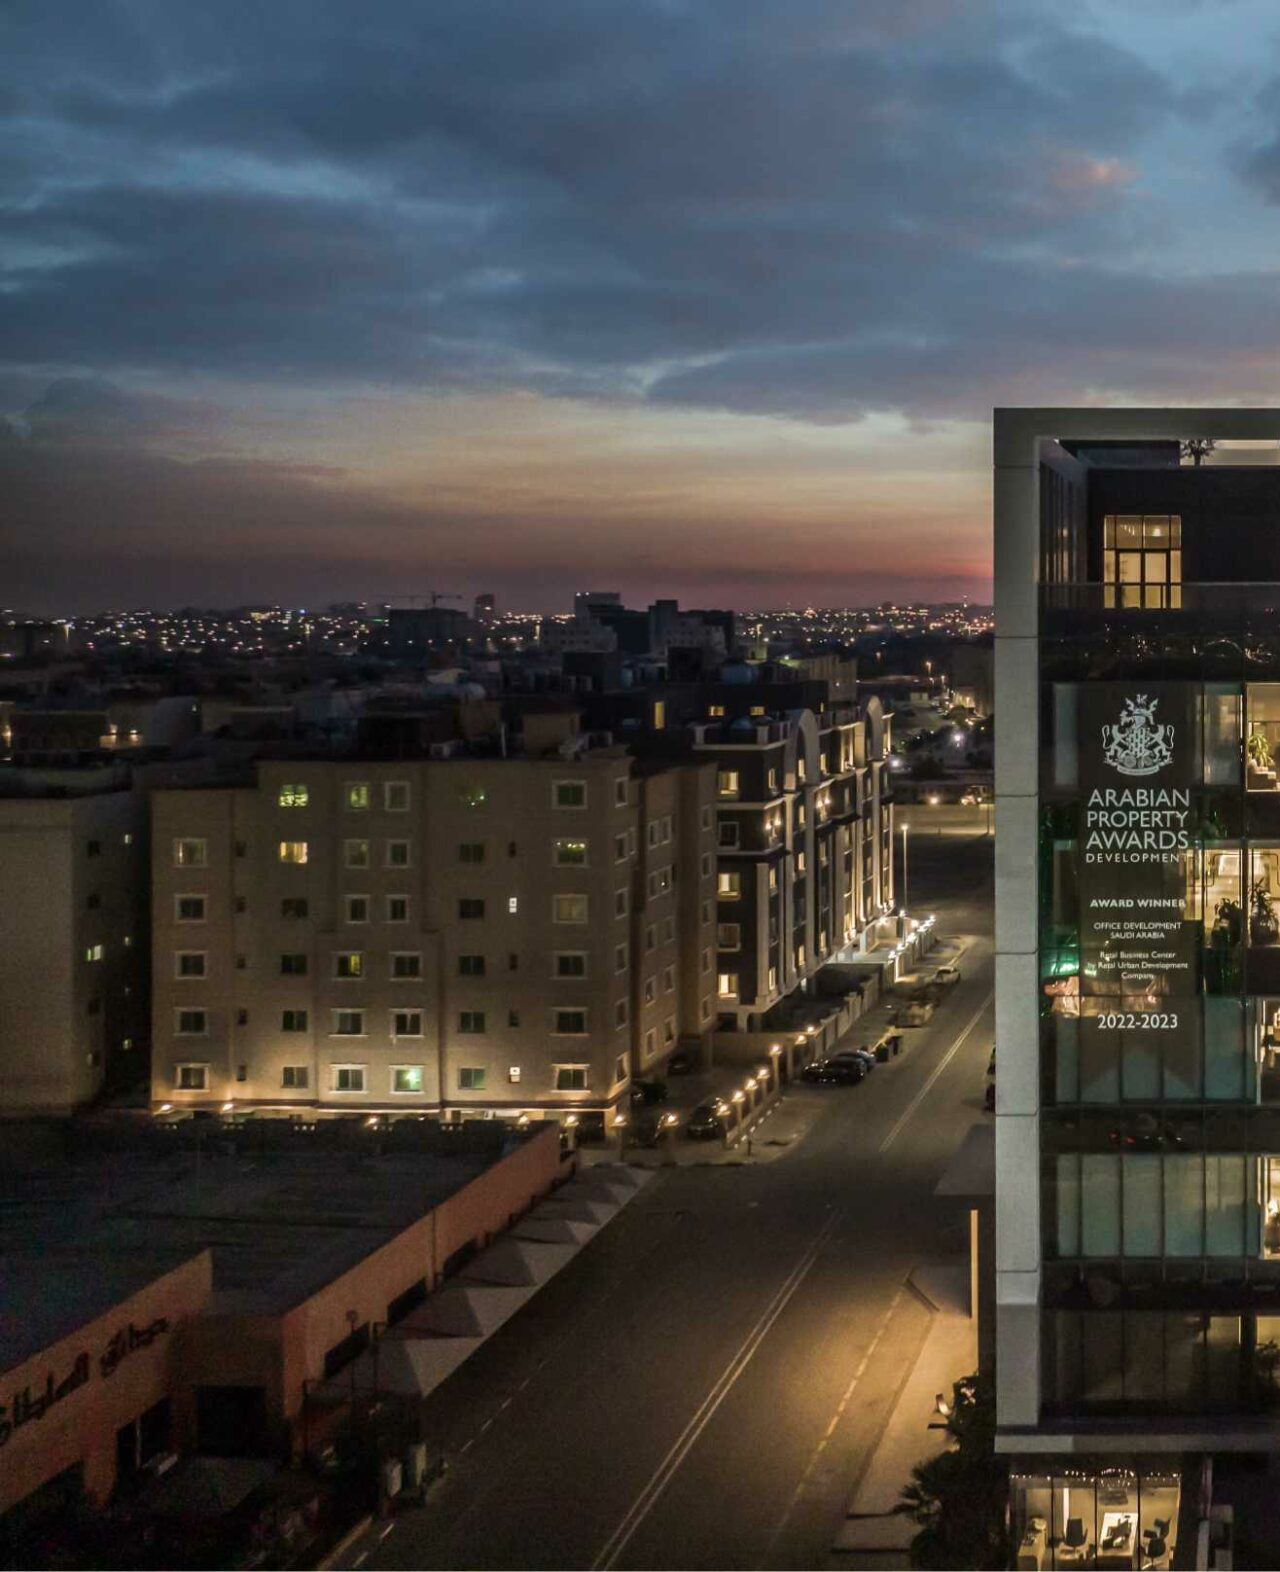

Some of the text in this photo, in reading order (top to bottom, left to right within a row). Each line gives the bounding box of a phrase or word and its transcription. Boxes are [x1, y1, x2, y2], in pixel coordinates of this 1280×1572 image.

[1087, 788, 1190, 807] ARABIAN
[1087, 811, 1188, 827] PROPERTY
[1086, 830, 1189, 849] AWARDS
[1085, 852, 1188, 863] DEVELOPMENT
[1089, 898, 1187, 908] AWARD WINNER
[1093, 922, 1182, 930] OFFICE DEVELOPMENT
[1110, 931, 1165, 939] SAUDI ARABIA
[1120, 951, 1149, 959] Business
[1151, 951, 1176, 959] Center
[1097, 960, 1116, 970] Retal
[1117, 960, 1140, 970] Urban
[1141, 961, 1188, 970] Development
[1121, 972, 1155, 980] Company
[1097, 1014, 1178, 1029] 2022-2023
